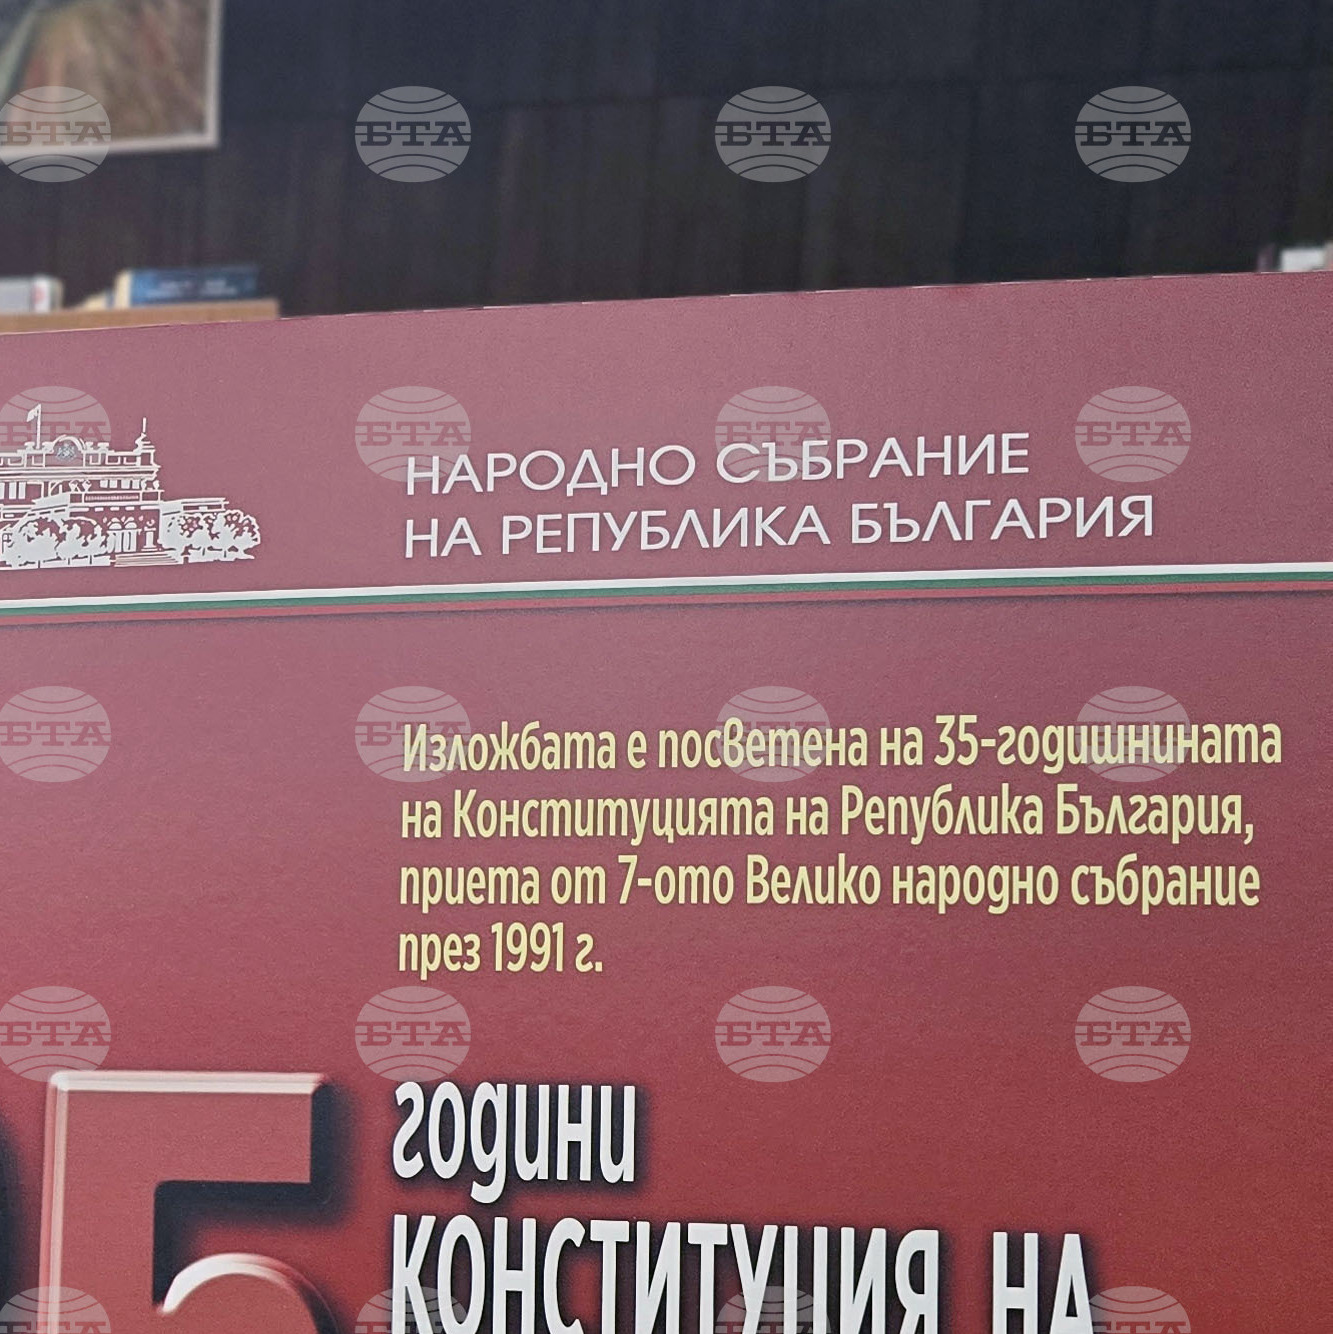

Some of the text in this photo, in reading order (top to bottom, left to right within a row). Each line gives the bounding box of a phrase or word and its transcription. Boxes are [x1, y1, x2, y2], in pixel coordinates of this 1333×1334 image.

[407, 432, 1029, 496] НАРОДНО СЪБРАНИЕ
[405, 495, 1153, 558] НА РЕПУБЛИКА БЪЛГАРИЯ
[403, 714, 1282, 774] Изложбата е посветена на 35-годишнината
[401, 783, 1254, 845] на Конституцията на Република България,
[400, 853, 1260, 915] приета от 7-ото Велико народно събрание
[399, 922, 603, 980] през 1991 г.
[393, 1081, 636, 1203] години
